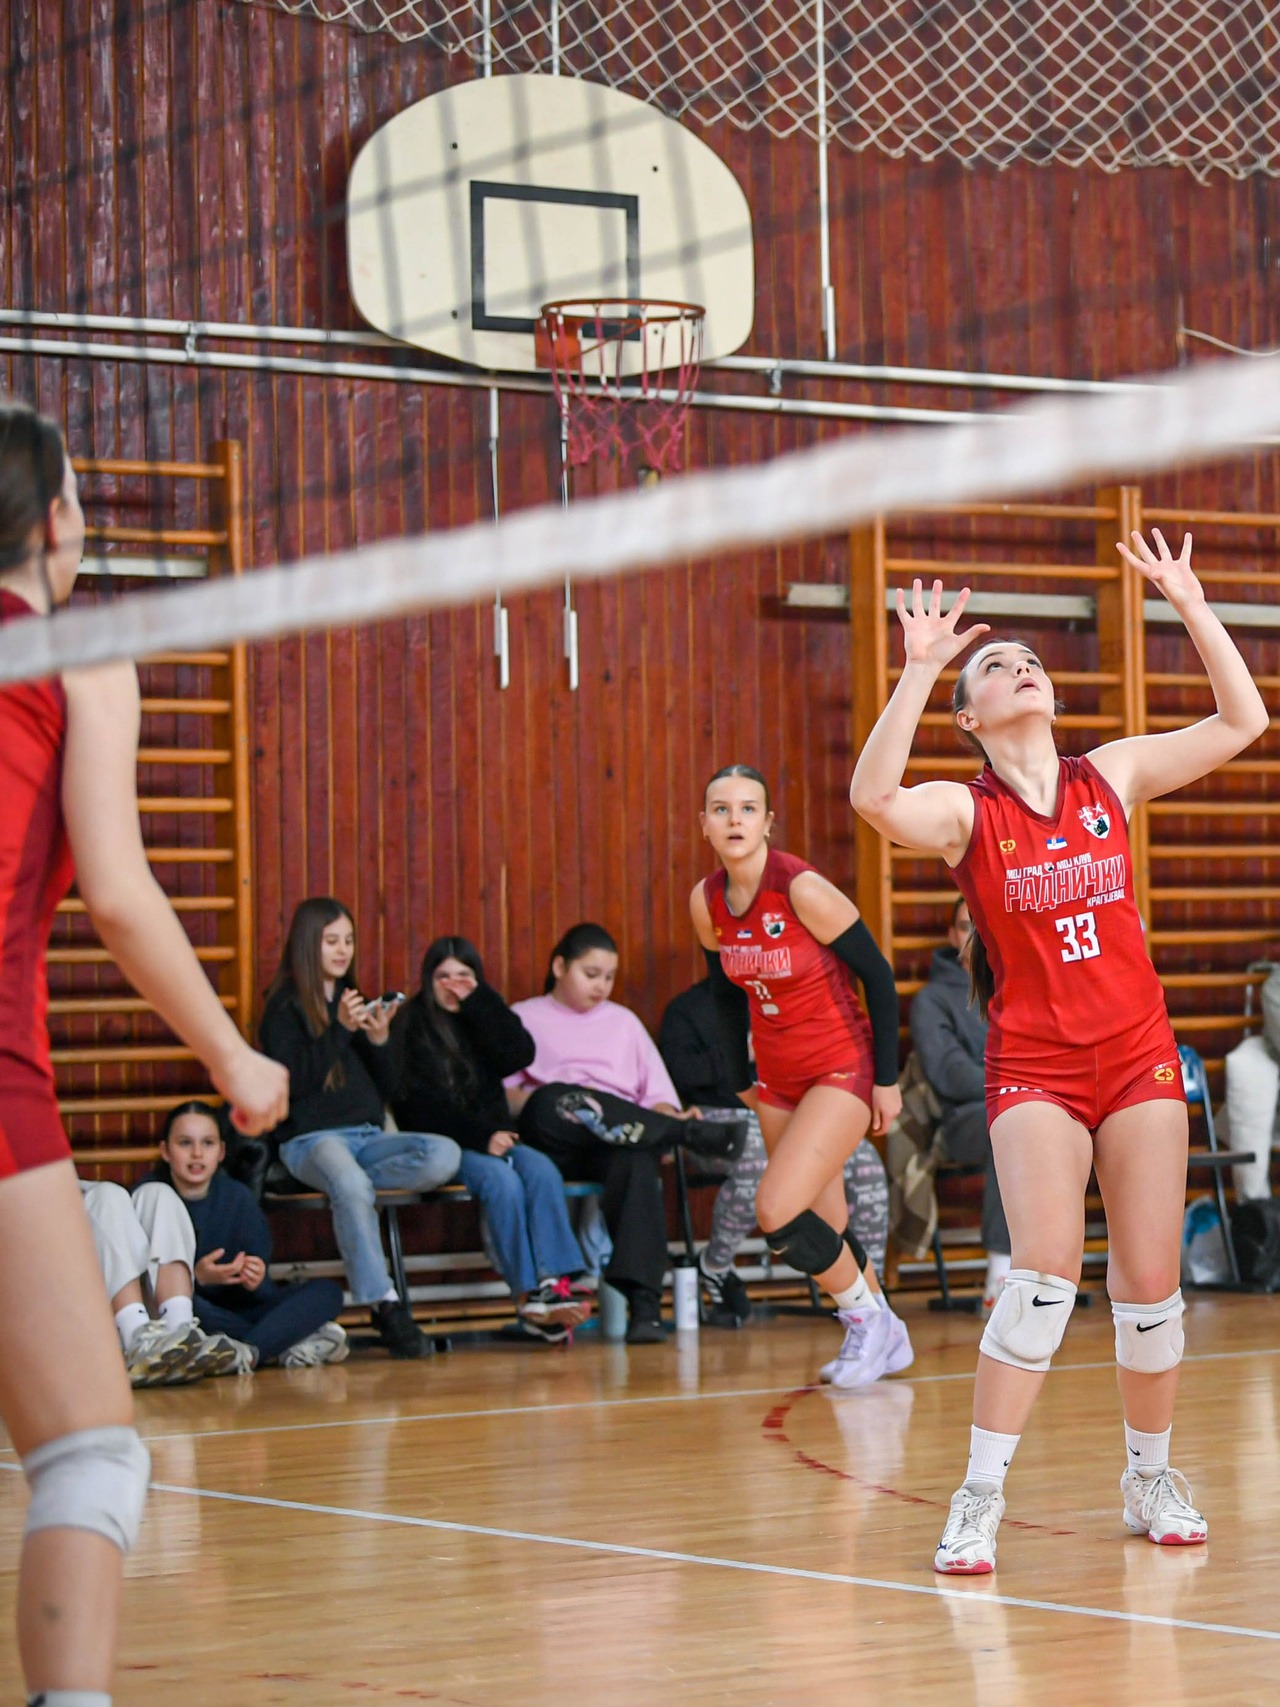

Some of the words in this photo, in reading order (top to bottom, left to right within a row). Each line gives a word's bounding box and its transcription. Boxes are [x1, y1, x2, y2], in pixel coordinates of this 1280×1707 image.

[1005, 854, 1126, 912] РАДНИЧКИ
[1023, 864, 1043, 877] ГРАД
[1055, 912, 1101, 962] 33
